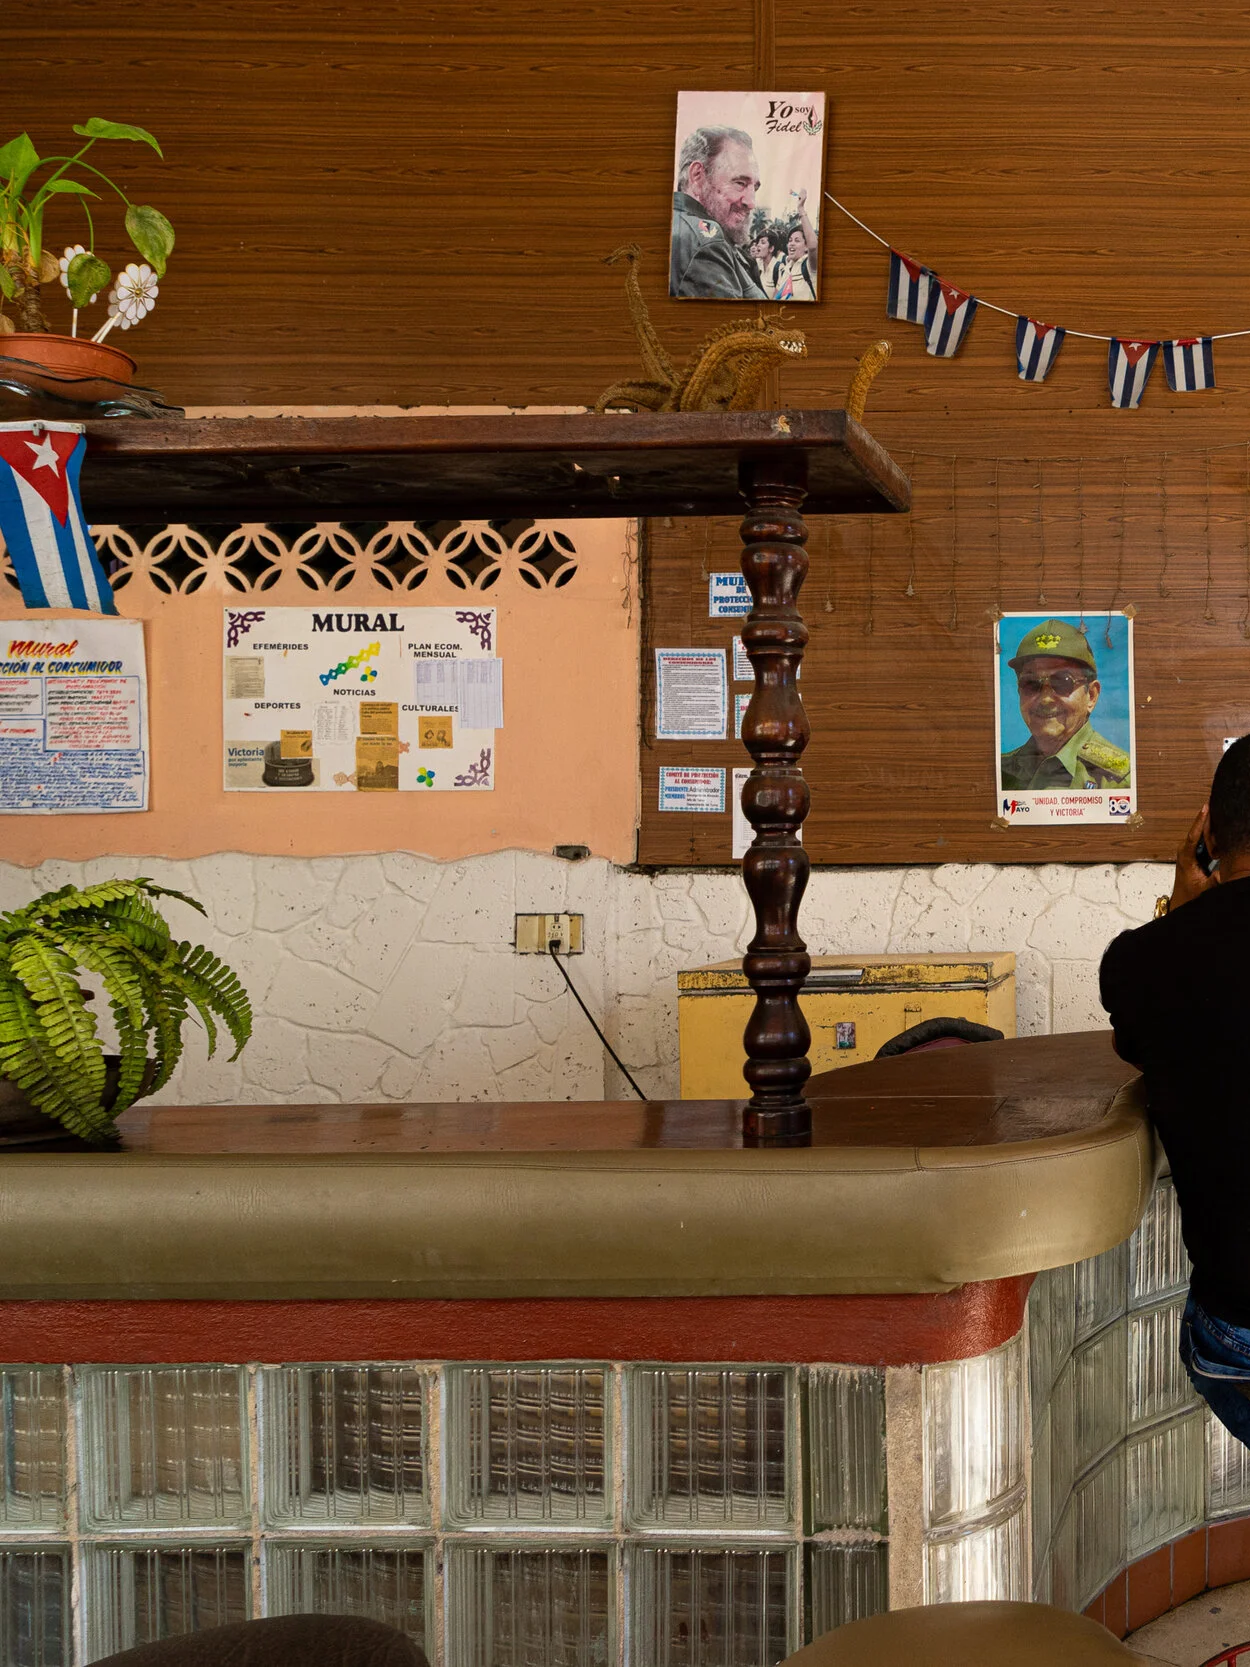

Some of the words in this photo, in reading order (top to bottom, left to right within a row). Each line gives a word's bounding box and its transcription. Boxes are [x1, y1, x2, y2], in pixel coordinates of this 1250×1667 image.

[765, 101, 793, 119] Yo
[794, 106, 810, 116] soy
[765, 119, 802, 135] Fidel
[312, 613, 405, 632] MURAL
[8, 640, 79, 659] Mural
[253, 642, 309, 650] EFEMÉRIDES
[434, 643, 463, 651] ECOM.
[30, 661, 45, 675] AL
[47, 660, 123, 675] CONSUMIDOR
[254, 702, 301, 710] DEPORTES
[228, 747, 265, 757] Victoria
[689, 786, 720, 794] Administrador
[1060, 796, 1103, 804] COMPROMISO
[1049, 808, 1054, 817] Y
